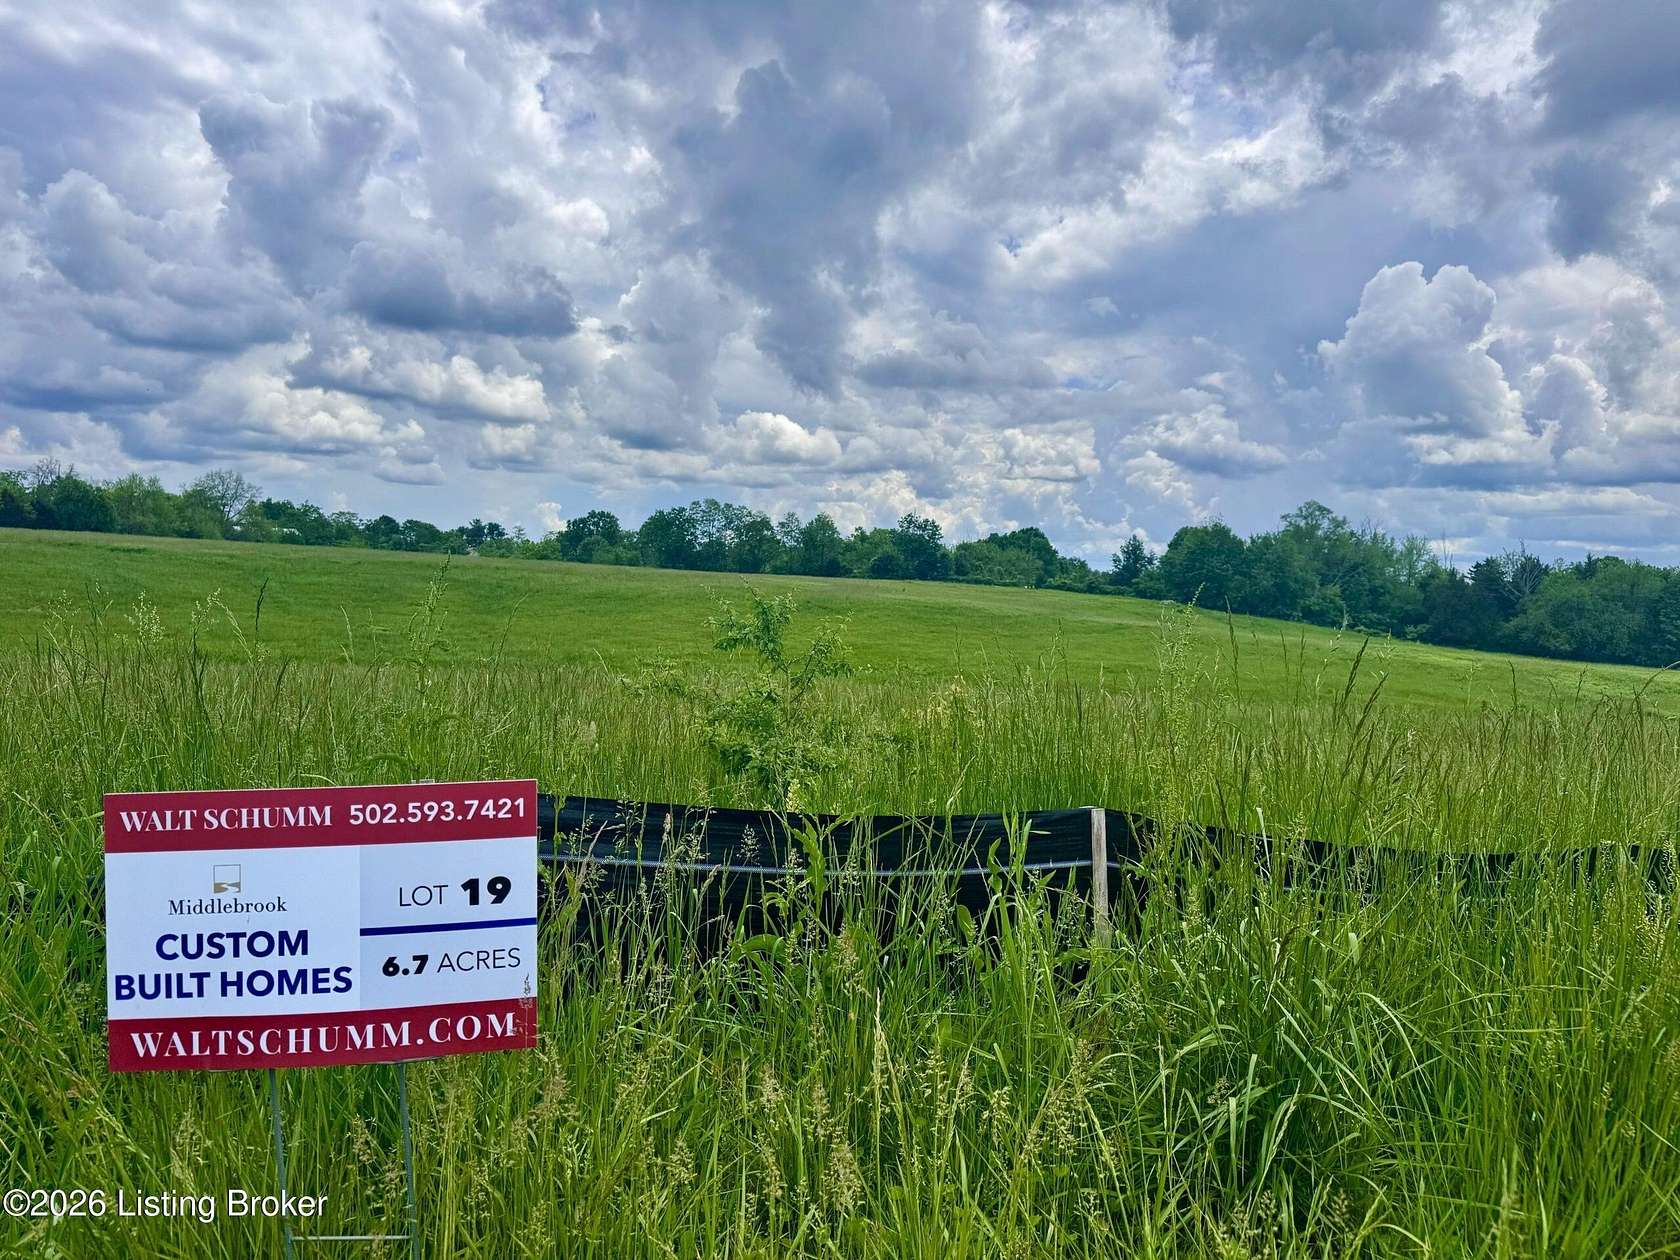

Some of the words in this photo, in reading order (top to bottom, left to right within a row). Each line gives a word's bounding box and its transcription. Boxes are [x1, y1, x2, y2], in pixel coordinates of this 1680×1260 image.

[120, 809, 198, 832] WALT
[203, 805, 333, 830] SCHUMM
[349, 797, 525, 825] 502.593.7421
[168, 896, 287, 916] Middlebrook
[399, 884, 449, 907] LOT
[460, 875, 512, 906] 19
[155, 929, 309, 961] CUSTOM
[382, 954, 429, 977] 6.7
[436, 947, 521, 974] ACRES
[115, 971, 211, 1001] BUILT
[220, 966, 353, 998] HOMES
[130, 1011, 517, 1058] WALTSCHUMM.COM
